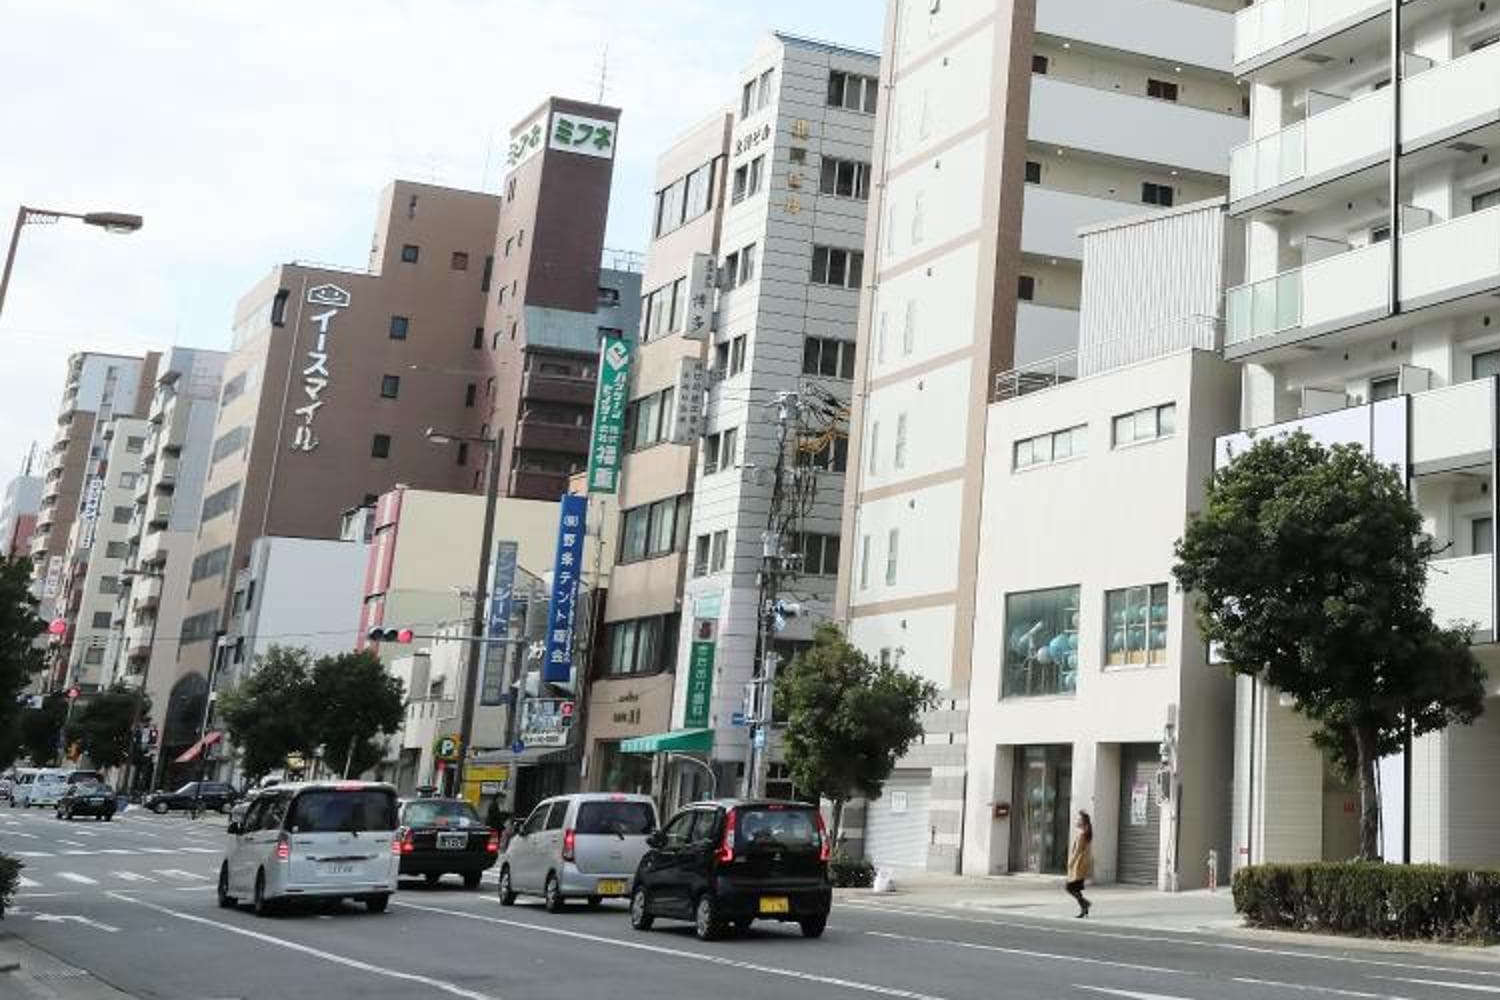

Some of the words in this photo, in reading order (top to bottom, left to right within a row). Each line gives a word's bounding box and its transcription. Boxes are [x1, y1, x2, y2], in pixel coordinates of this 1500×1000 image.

[555, 118, 612, 151] ミフネ
[294, 309, 339, 451] イースマイル
[441, 739, 454, 755] P
